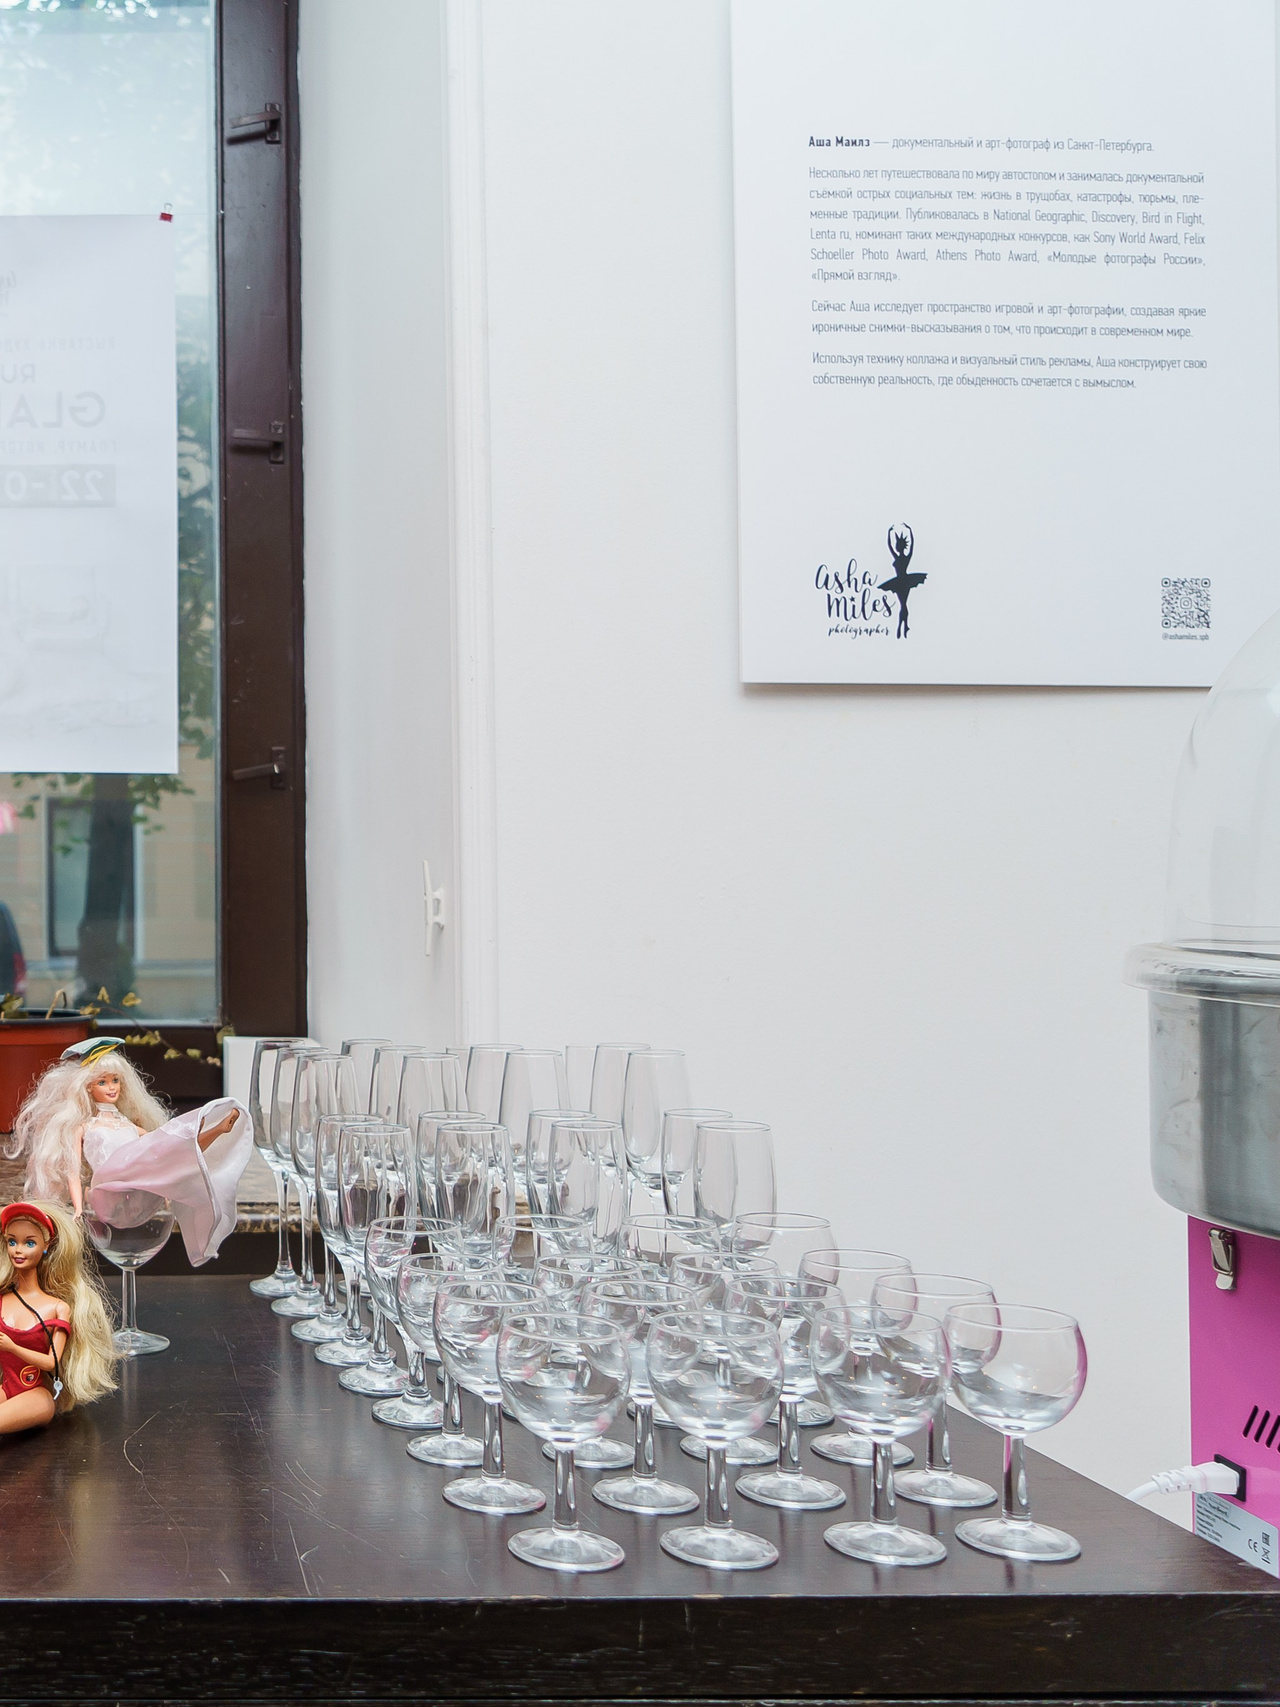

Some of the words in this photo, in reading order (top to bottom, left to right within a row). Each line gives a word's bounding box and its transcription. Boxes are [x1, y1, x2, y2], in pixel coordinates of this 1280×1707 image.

[809, 136, 831, 147] Аша
[835, 136, 870, 147] Маилз
[892, 135, 973, 150] документальный
[985, 137, 1050, 152] арт-фотограф
[1053, 141, 1064, 149] из
[808, 166, 860, 178] Несколько
[863, 169, 877, 178] лет
[881, 169, 959, 181] путешествовала
[962, 170, 973, 179] по
[976, 170, 999, 182] миру
[1002, 170, 1056, 180] автостопом
[1058, 172, 1064, 180] и
[1066, 172, 1123, 182] занималась
[1125, 171, 1204, 185] документальной
[809, 186, 852, 199] съёмкой
[856, 189, 890, 201] острых
[894, 190, 952, 200] социальных
[957, 190, 976, 199] тем:
[980, 191, 1011, 200] жизнь
[1016, 191, 1021, 200] в
[1026, 188, 1072, 204] трущобах,
[1076, 190, 1134, 205] катастрофы,
[1138, 194, 1178, 205] тюрьмы,
[1182, 194, 1204, 203] пле-
[810, 210, 848, 219] менные
[852, 210, 901, 222] традиции.
[906, 207, 978, 223] Публиковалась
[983, 211, 988, 220] в
[993, 209, 1030, 220] National
[1034, 209, 1087, 224] Geographic,
[1091, 210, 1138, 226] Discovery,
[1142, 211, 1160, 223] Bird
[1164, 214, 1172, 223] in
[1176, 211, 1204, 227] Flight,
[855, 230, 901, 239] номинант
[906, 231, 932, 239] таких
[935, 231, 1015, 243] международных
[1018, 232, 1069, 244] конкурсов,
[1073, 233, 1090, 242] как
[1093, 231, 1115, 246] Sony
[1118, 231, 1145, 243] World
[1149, 232, 1180, 245] Award,
[1184, 232, 1205, 244] Felix
[810, 247, 854, 260] Schoeller
[862, 247, 888, 260] Photo
[896, 248, 928, 261] Award,
[936, 248, 967, 260] Athens
[974, 249, 1000, 261] Photo
[1008, 250, 1038, 263] Award,
[1047, 250, 1096, 264] «Молодые
[1104, 252, 1156, 267] фотографы
[1163, 252, 1204, 265] России»,
[812, 268, 854, 283] «Прямой
[857, 271, 899, 282] взгляд».
[811, 299, 845, 311] Сейчас
[850, 300, 870, 311] Аша
[874, 303, 922, 314] исследует
[927, 303, 991, 315] пространство
[995, 302, 1034, 316] игровой
[1130, 307, 1174, 317] создавая
[1178, 307, 1206, 319] яркие
[812, 323, 866, 335] ироничные
[868, 323, 982, 333] снимки-высказывания
[984, 324, 990, 333] о
[993, 324, 1012, 334] том,
[1015, 325, 1030, 334] что
[1033, 325, 1087, 337] происходит
[1090, 327, 1096, 335] в
[1099, 327, 1163, 339] современном
[1166, 328, 1193, 339] мире.
[812, 351, 863, 366] Используя
[866, 355, 904, 366] технику
[906, 355, 948, 364] коллажа
[951, 356, 957, 364] и
[960, 353, 1017, 368] визуальный
[1020, 356, 1046, 366] стиль
[1048, 357, 1092, 369] рекламы,
[1096, 355, 1115, 367] Аша
[1118, 358, 1180, 371] конструирует
[1183, 359, 1207, 368] свою
[812, 372, 875, 387] собственную
[877, 375, 934, 388] реальность,
[938, 376, 953, 386] где
[956, 373, 1018, 387] обыденность
[1021, 377, 1072, 386] сочетается
[1074, 378, 1079, 387] с
[1082, 378, 1136, 387] вымыслом.
